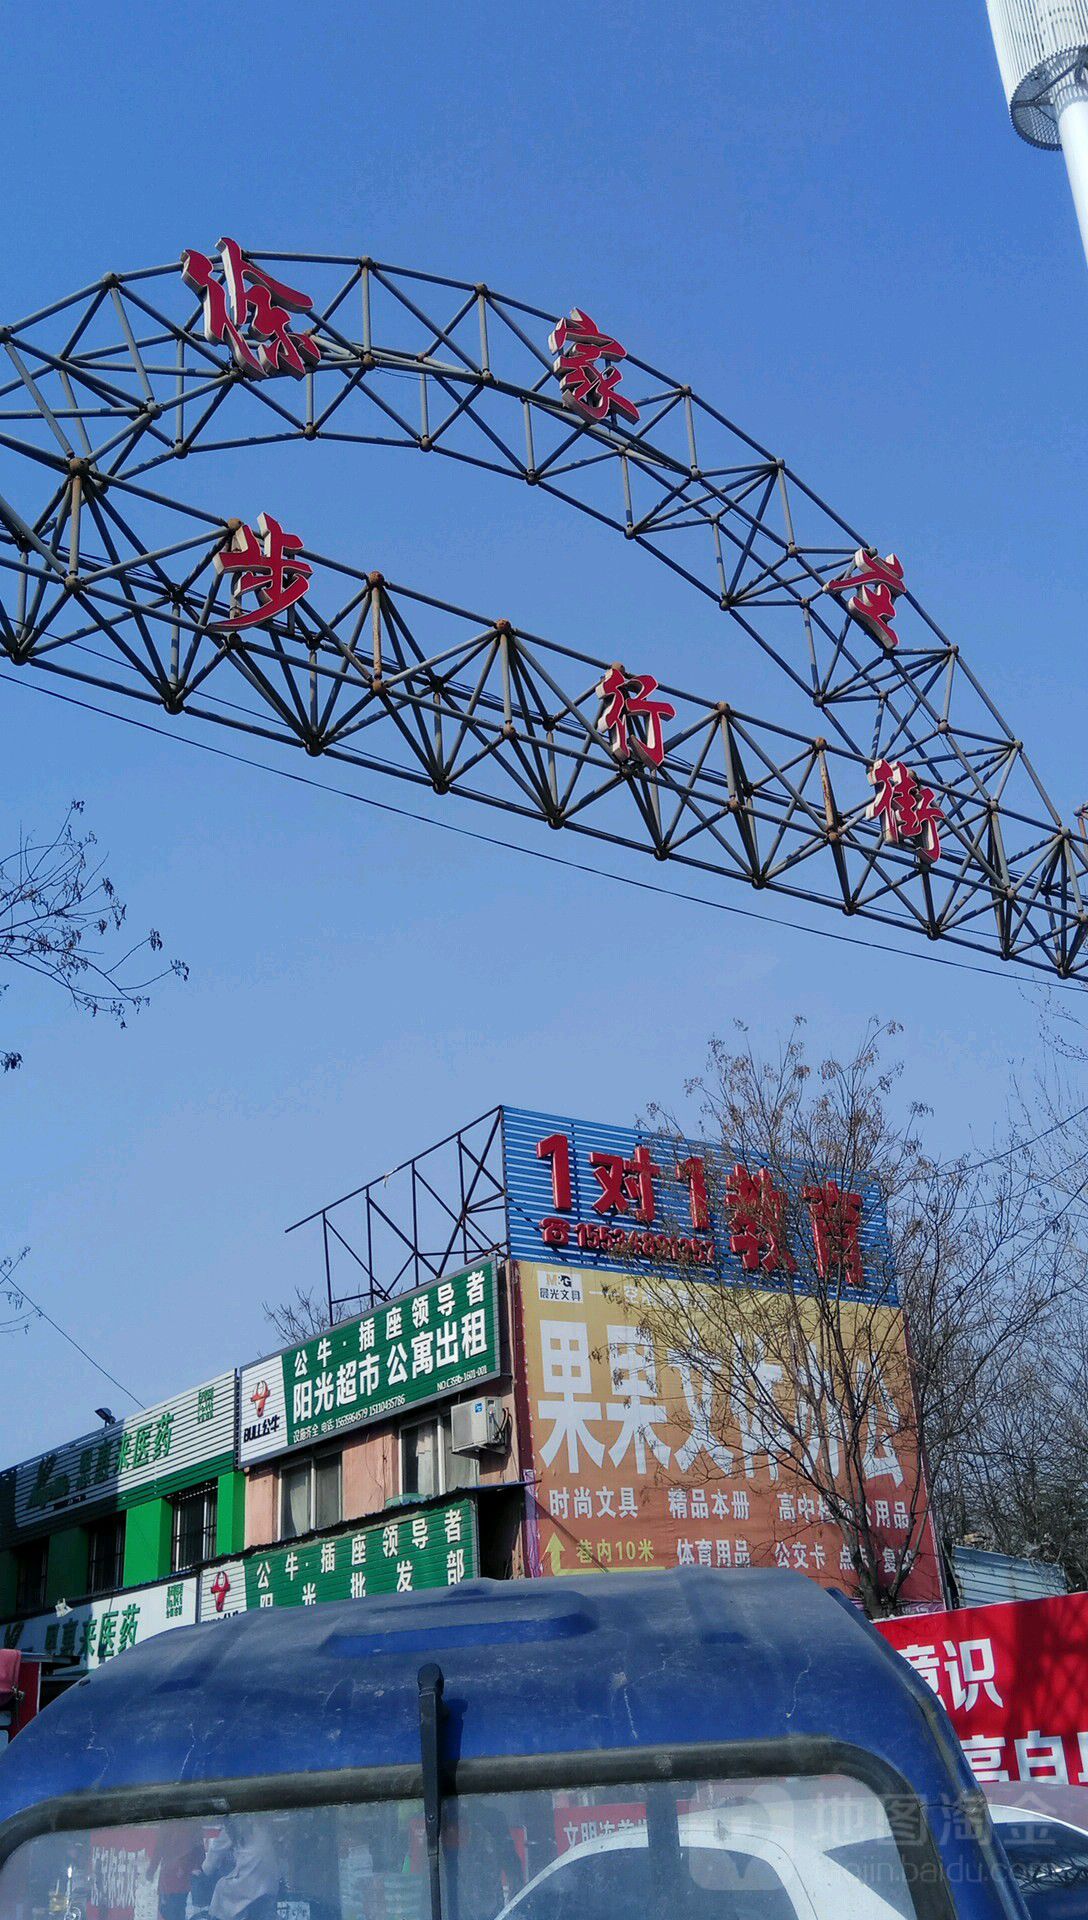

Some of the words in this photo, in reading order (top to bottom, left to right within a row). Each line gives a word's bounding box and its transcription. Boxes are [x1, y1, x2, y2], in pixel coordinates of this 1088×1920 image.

[549, 1486, 638, 1519] 时尚文具
[667, 1488, 750, 1520] 精品本册
[576, 1538, 655, 1564] 巷内10米
[676, 1538, 751, 1568] 体育用品
[774, 1541, 826, 1570] 公交卡
